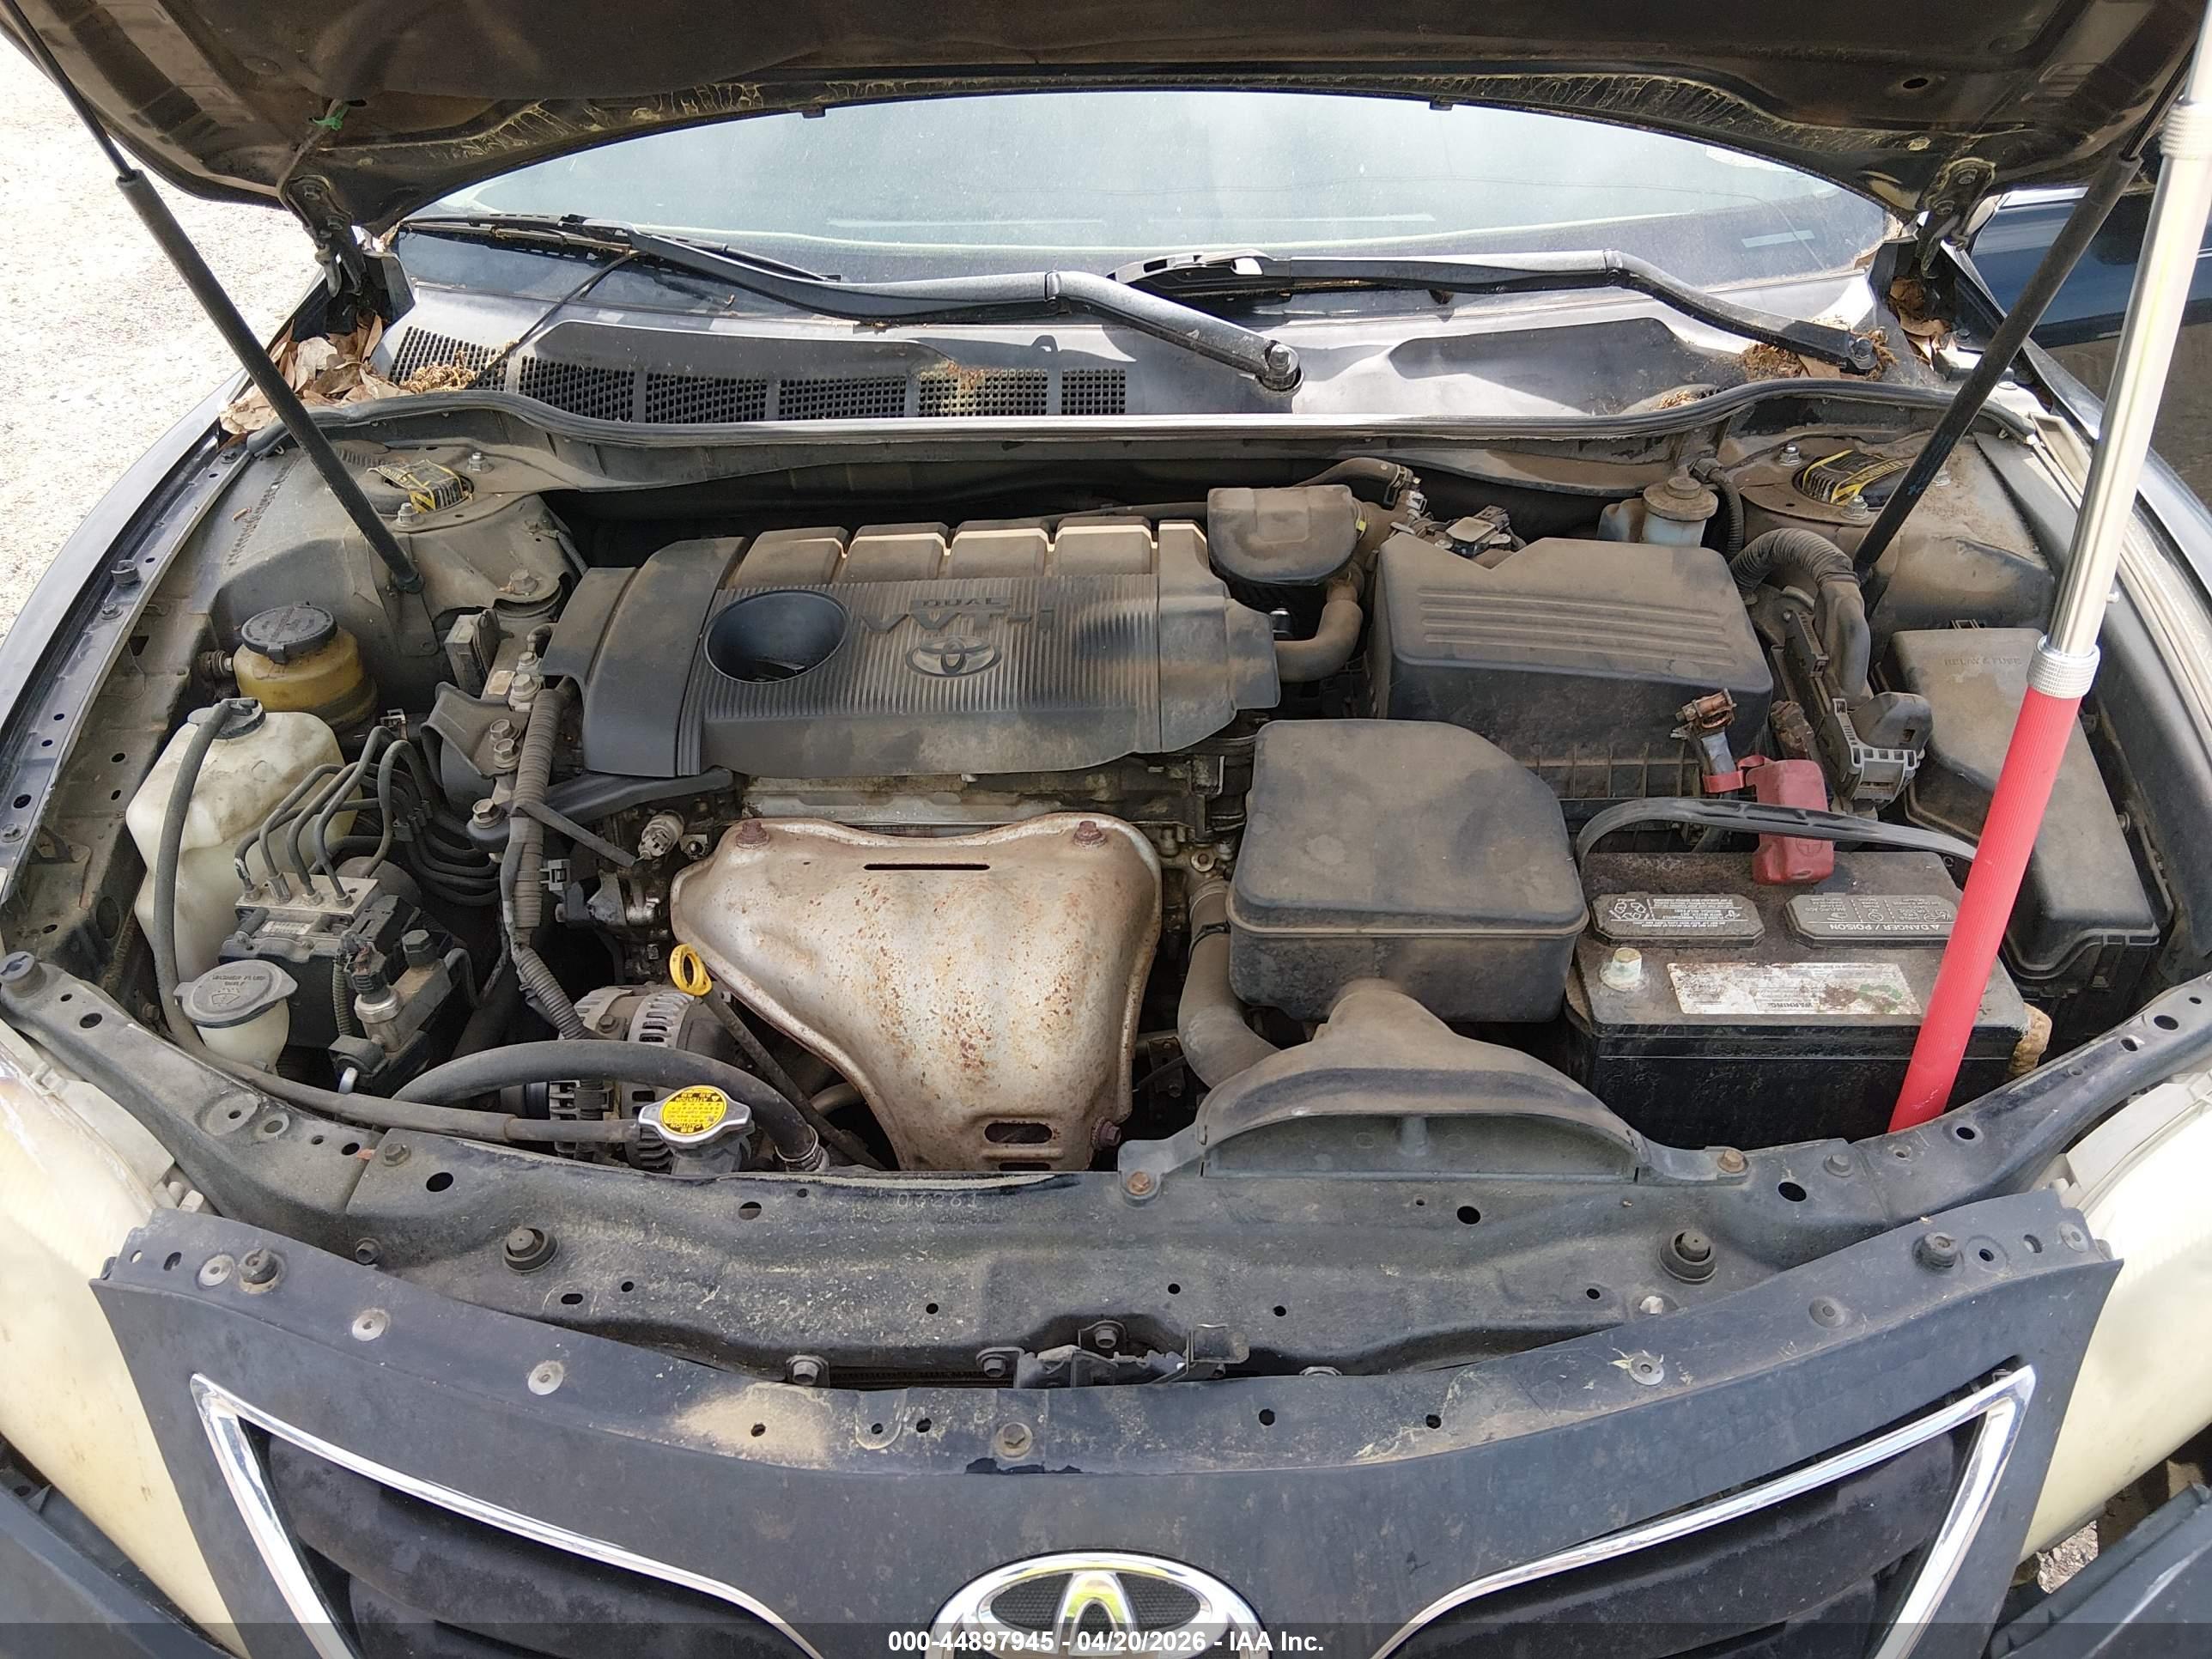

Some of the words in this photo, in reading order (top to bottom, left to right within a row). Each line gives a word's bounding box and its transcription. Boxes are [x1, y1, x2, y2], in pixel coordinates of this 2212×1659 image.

[922, 598, 1000, 606] DUAL
[1944, 658, 1979, 666] RELAY
[1991, 657, 2022, 665] FUSE
